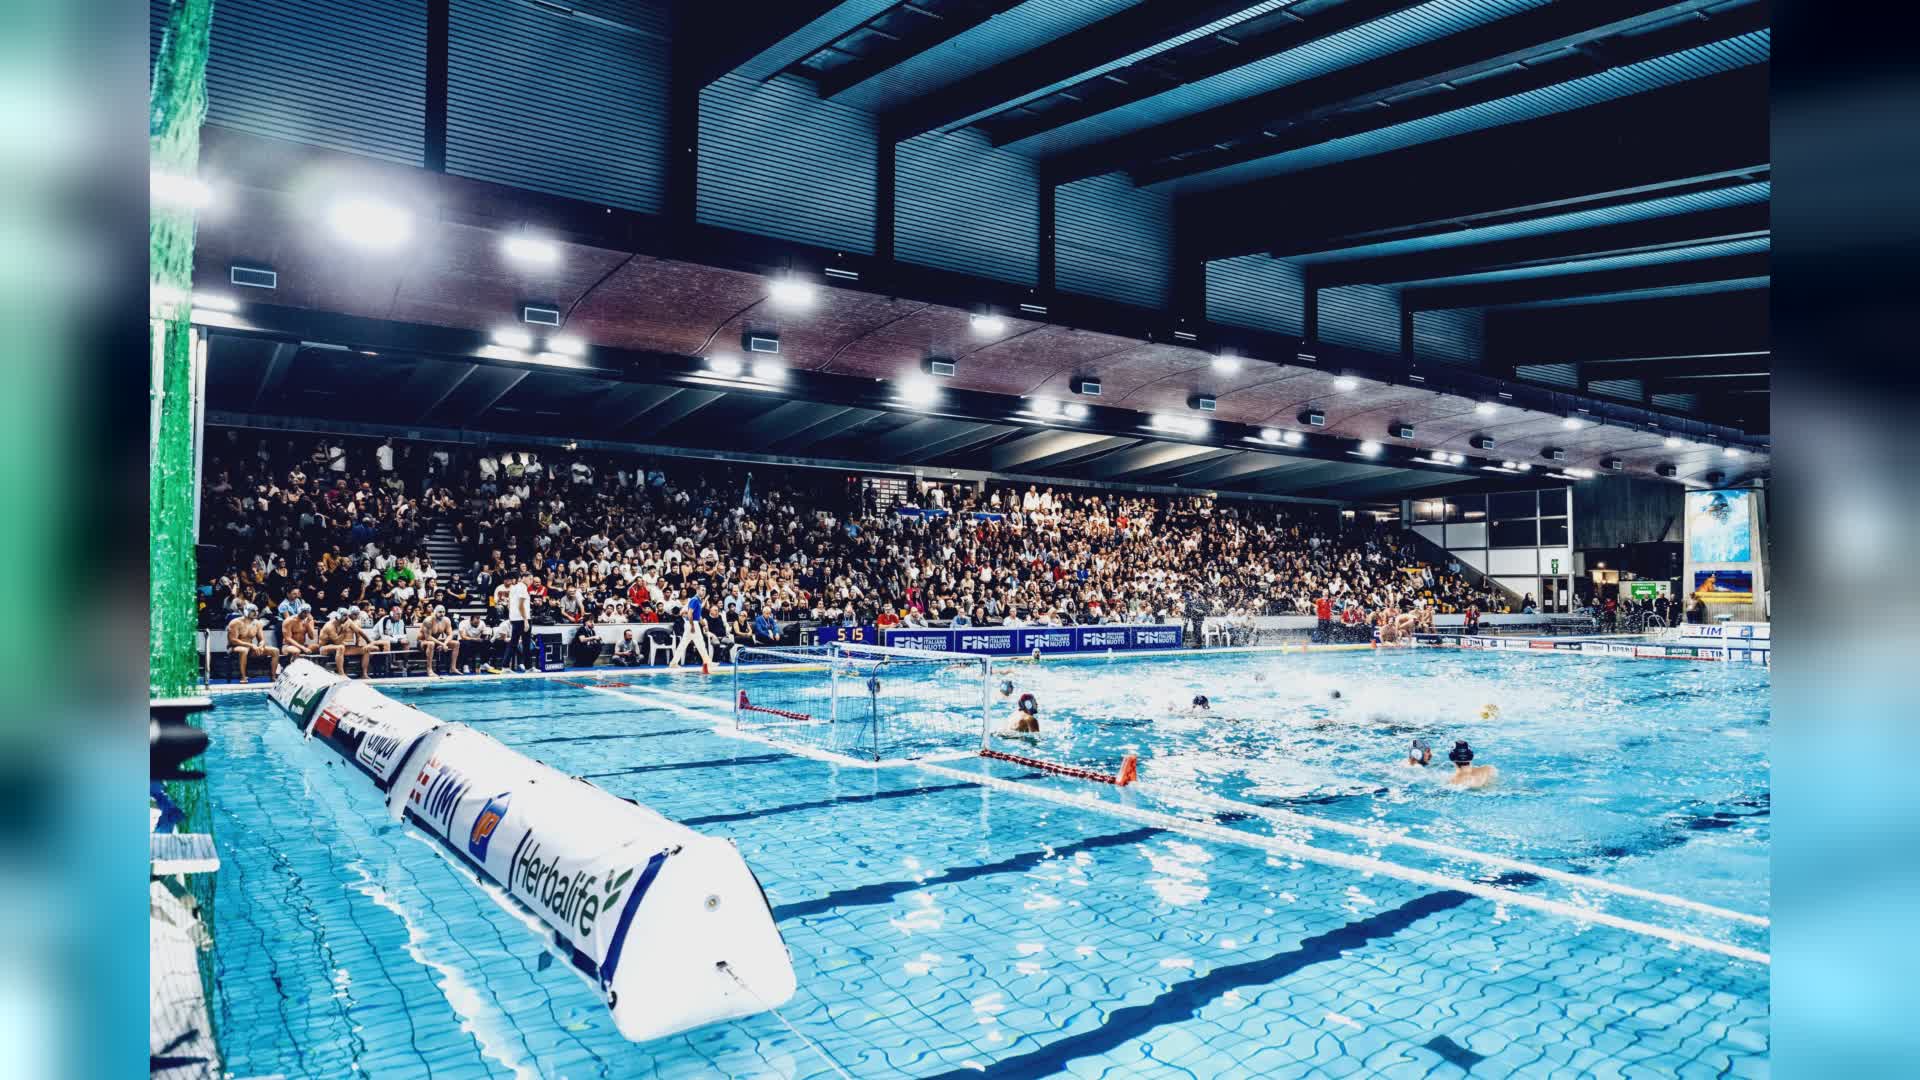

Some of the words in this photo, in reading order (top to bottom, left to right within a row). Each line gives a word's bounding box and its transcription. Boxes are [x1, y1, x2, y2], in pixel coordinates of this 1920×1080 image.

[1700, 626, 1722, 636] TIM
[424, 766, 464, 826] TIM
[515, 838, 599, 937] Herbalife
